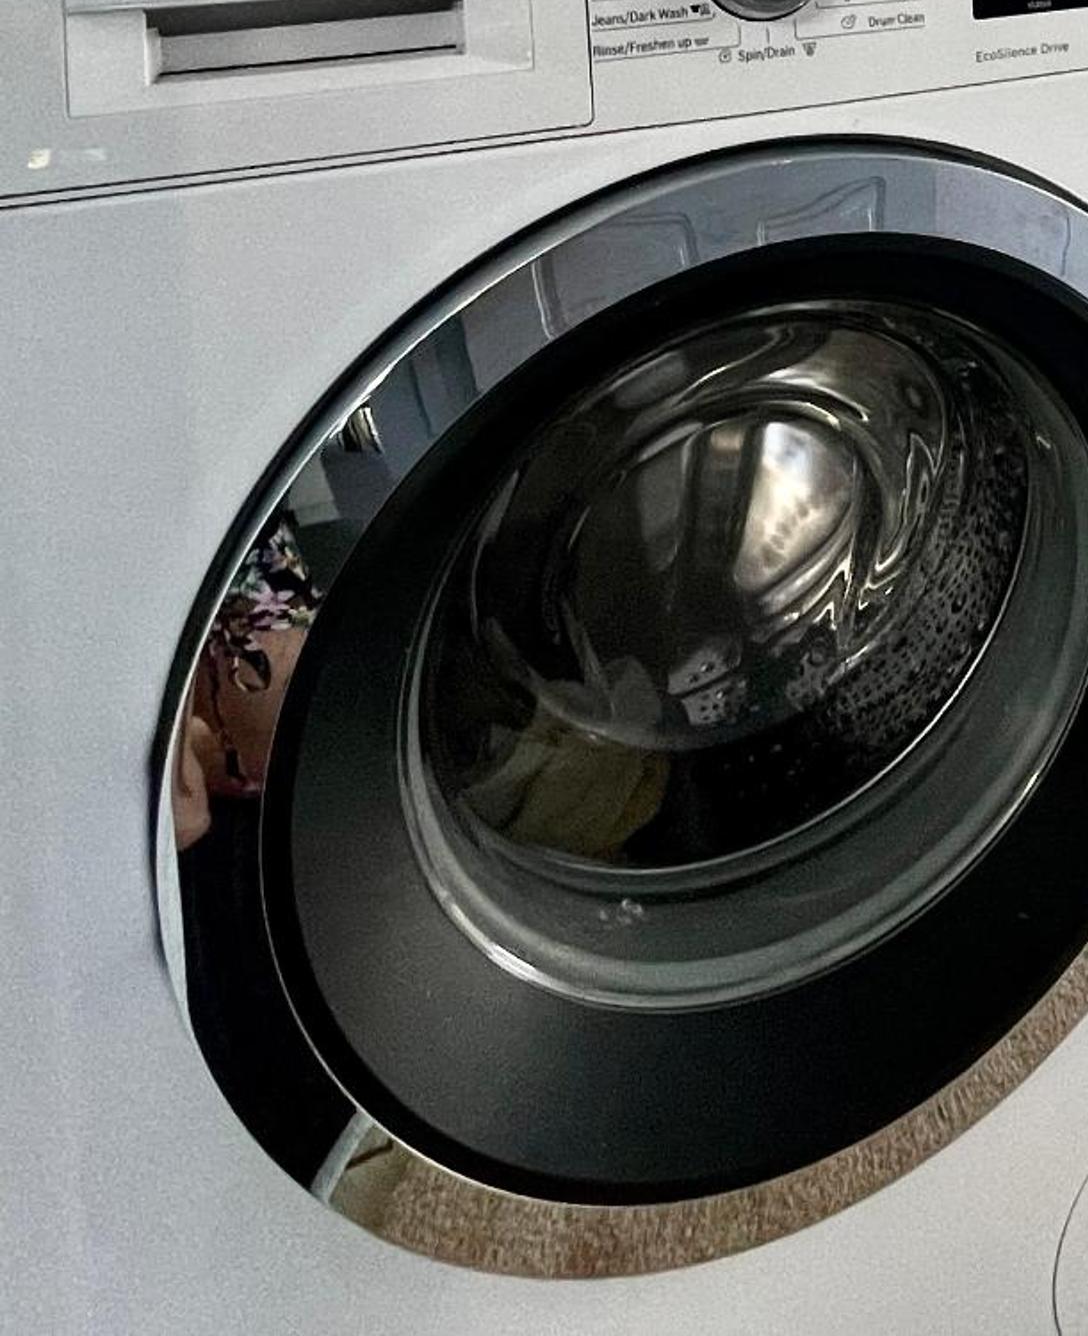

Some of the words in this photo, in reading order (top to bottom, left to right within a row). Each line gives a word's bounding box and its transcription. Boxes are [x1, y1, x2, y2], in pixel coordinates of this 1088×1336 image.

[591, 9, 657, 27] Jeans/Dark
[657, 6, 689, 20] Wash
[868, 15, 896, 28] Drum
[897, 11, 926, 25] Clean
[592, 38, 676, 57] Rinse/Freshen
[676, 38, 692, 49] up
[737, 45, 796, 64] Spin/Drain
[975, 46, 1037, 63] EcoSilence
[1040, 42, 1070, 55] Drive
